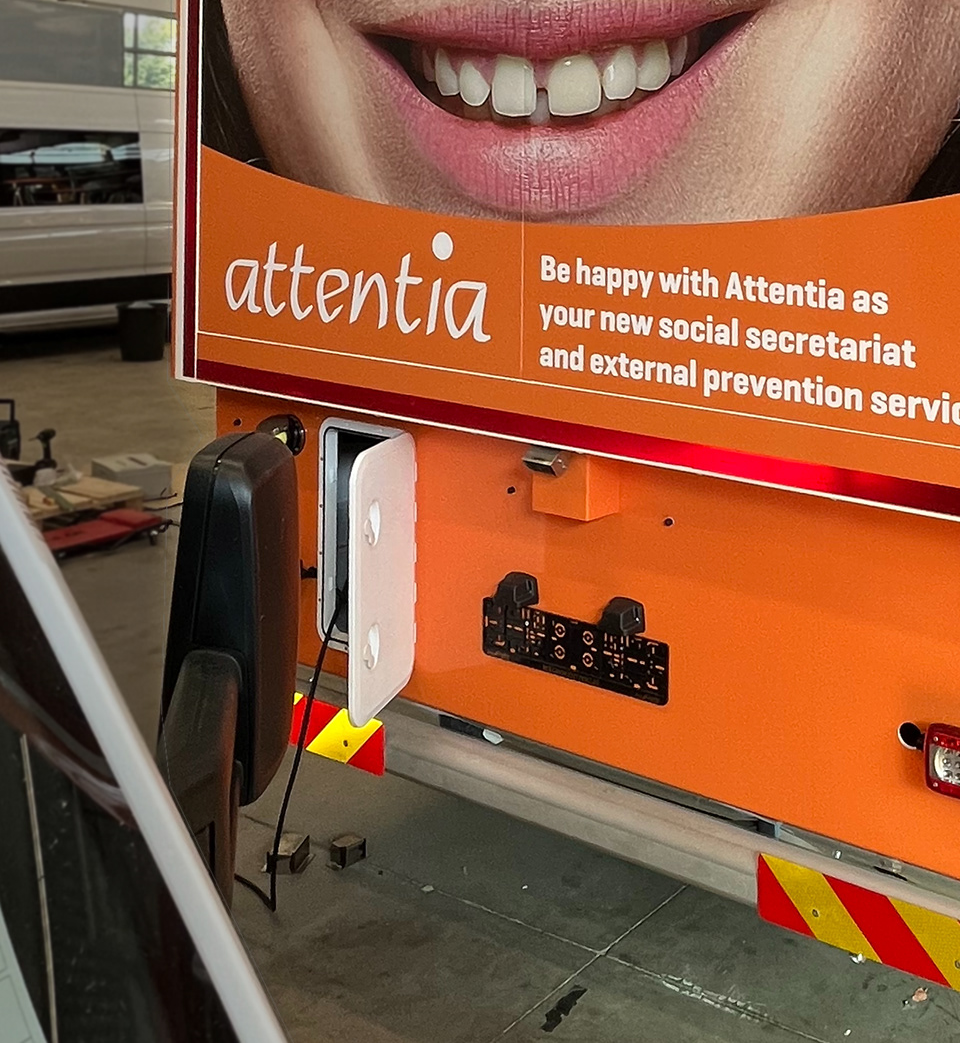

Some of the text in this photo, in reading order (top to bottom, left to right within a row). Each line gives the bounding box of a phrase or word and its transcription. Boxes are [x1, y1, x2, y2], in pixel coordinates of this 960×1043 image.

[224, 230, 492, 344] attentia
[540, 254, 889, 315] Be happy with Attentia as
[539, 303, 917, 369] your new social secretariat
[539, 344, 585, 372] and
[589, 352, 697, 388] external
[703, 368, 863, 412] prevention
